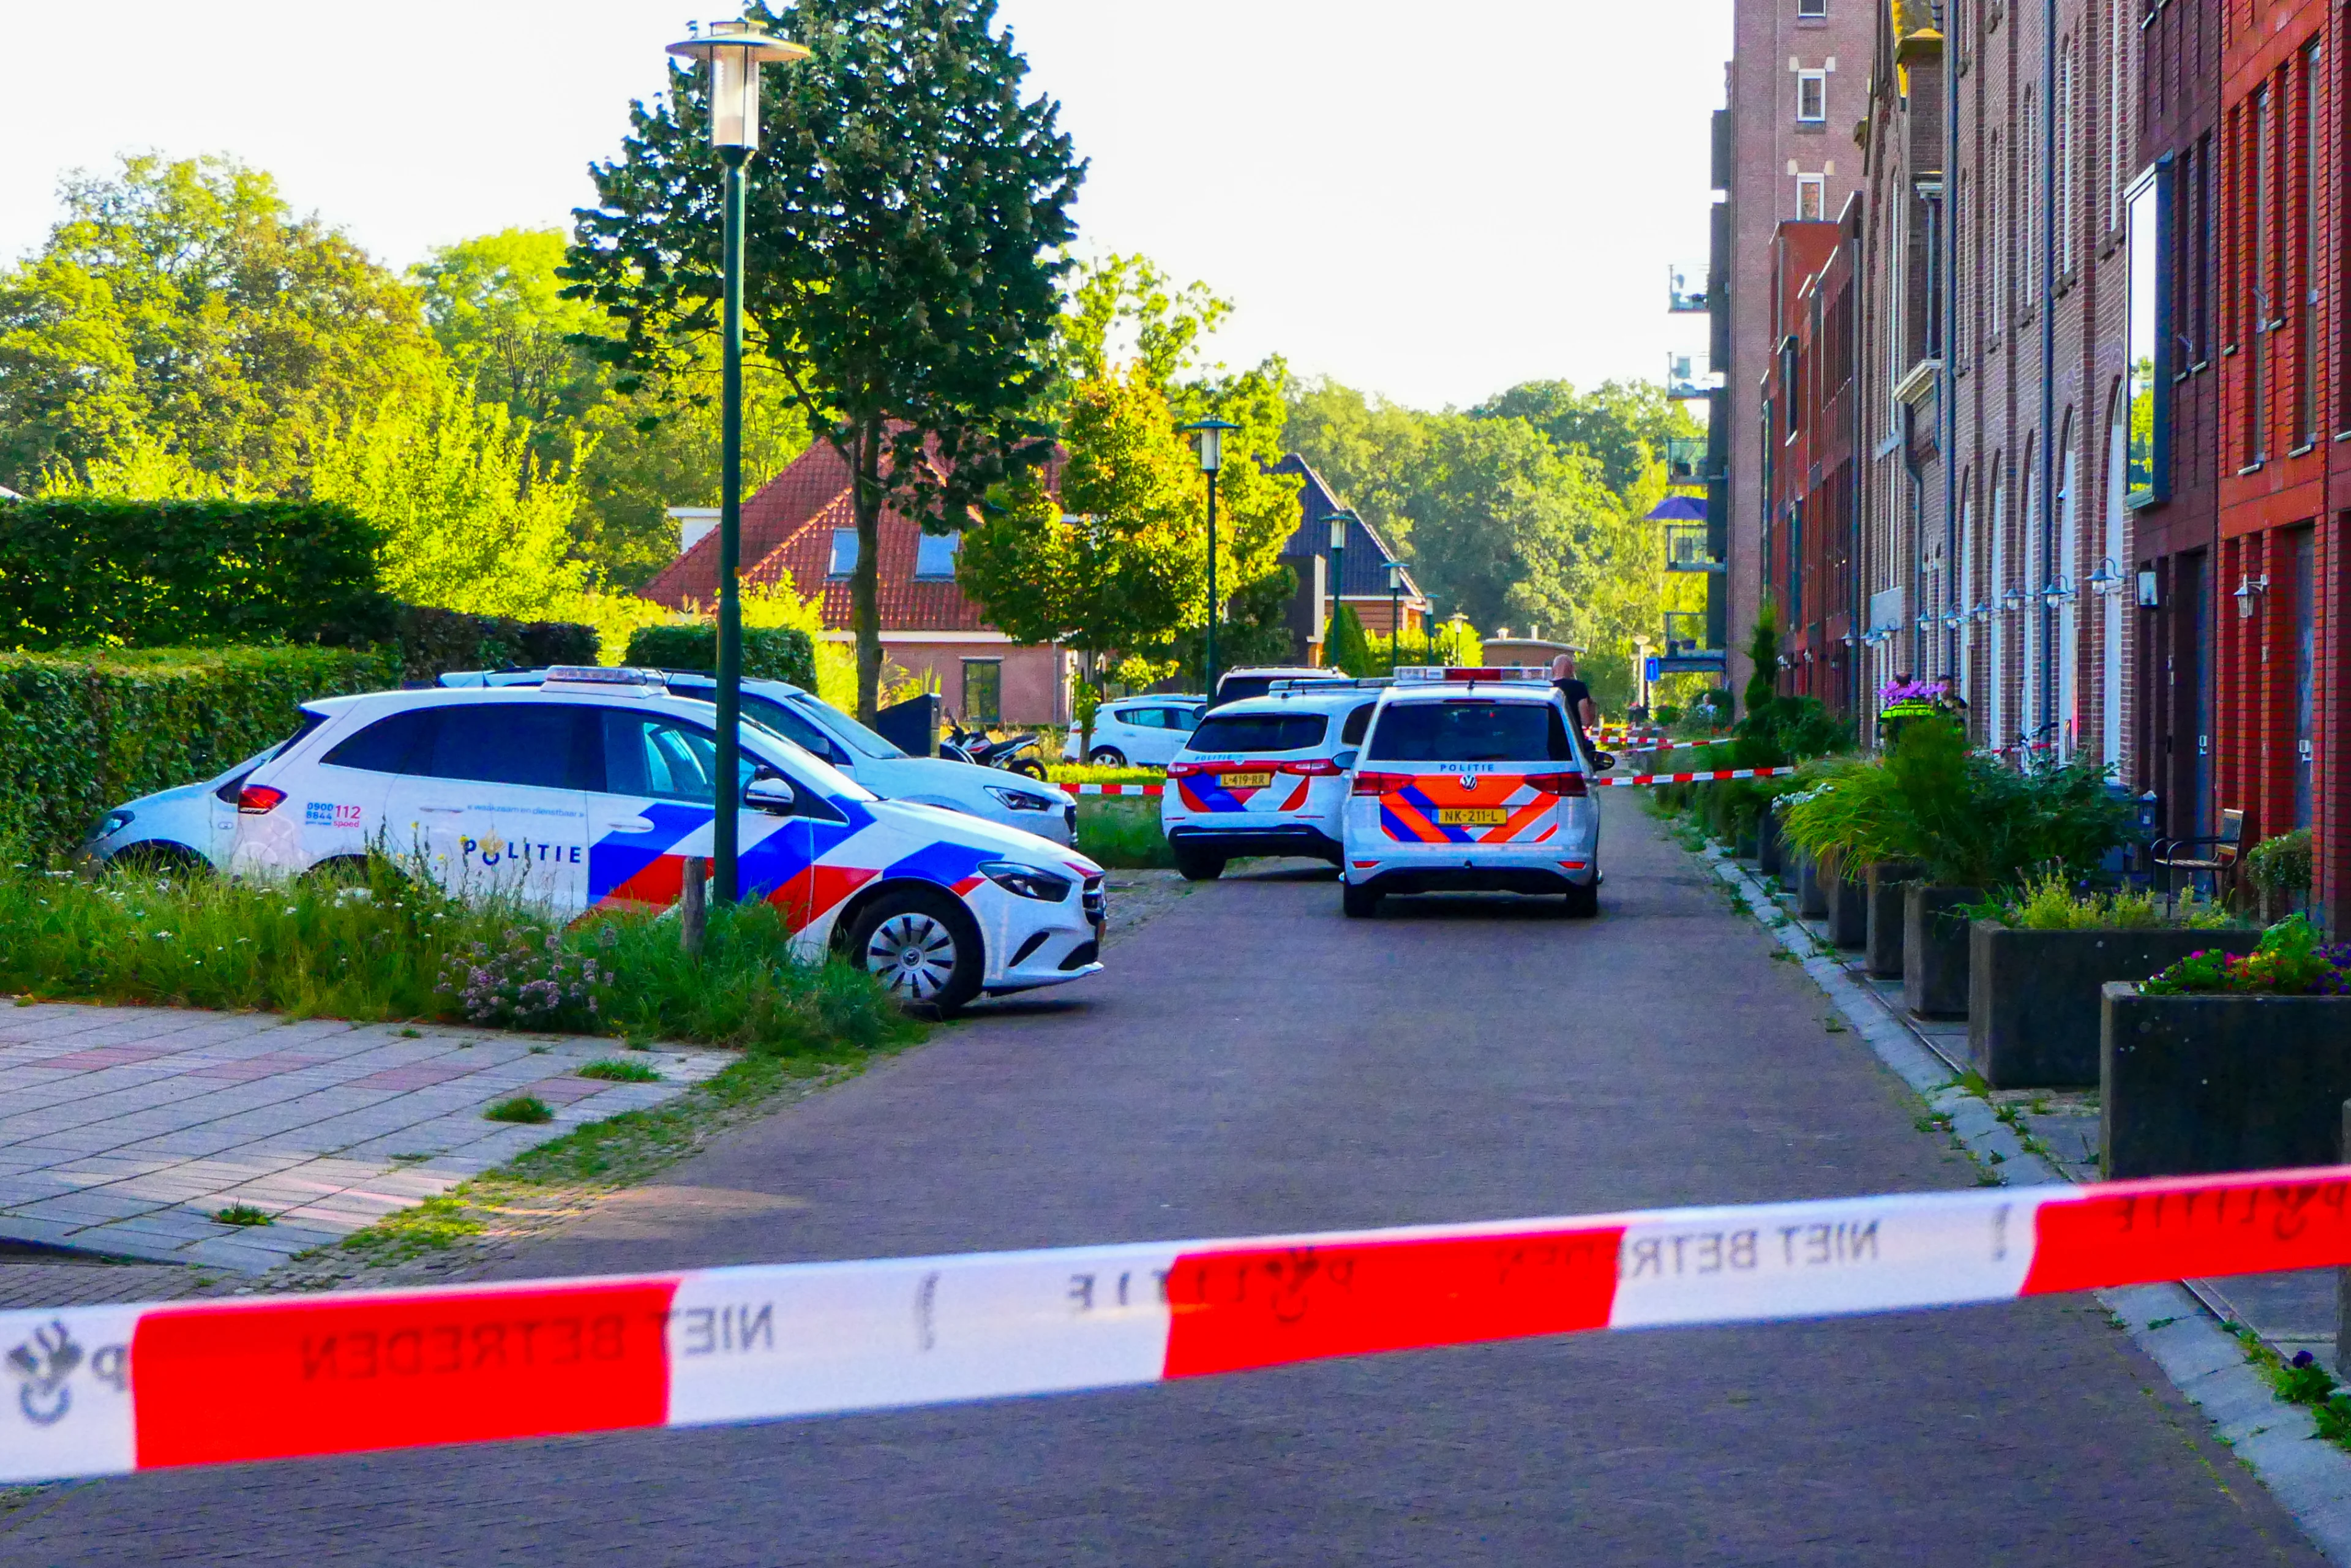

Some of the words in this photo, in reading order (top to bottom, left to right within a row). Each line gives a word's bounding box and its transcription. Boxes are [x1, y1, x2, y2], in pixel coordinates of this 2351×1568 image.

[1440, 763, 1494, 772] POLITIE
[307, 802, 334, 811] 0900
[306, 811, 332, 820] 8844
[336, 805, 361, 819] 112
[1445, 810, 1498, 822] NK-211-L
[463, 838, 581, 866] POLITIE
